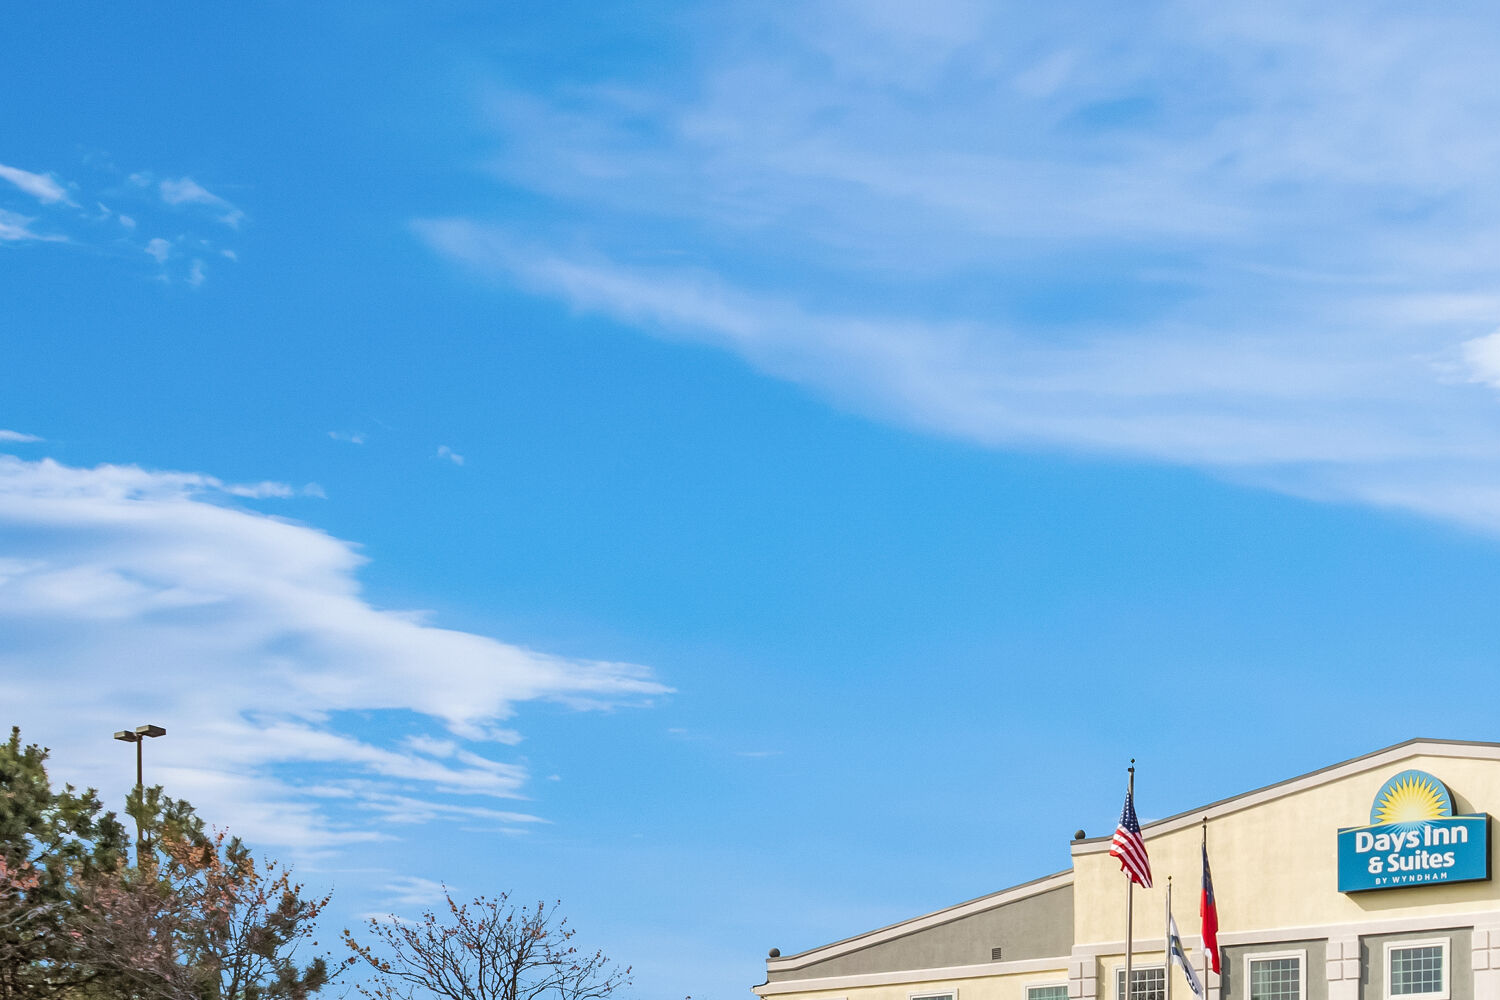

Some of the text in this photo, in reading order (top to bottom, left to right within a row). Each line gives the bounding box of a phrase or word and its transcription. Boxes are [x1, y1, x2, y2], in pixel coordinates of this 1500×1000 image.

[1355, 825, 1468, 853] Days Inn
[1368, 850, 1455, 874] & Suites
[1375, 872, 1448, 885] BY WYNDHAM
